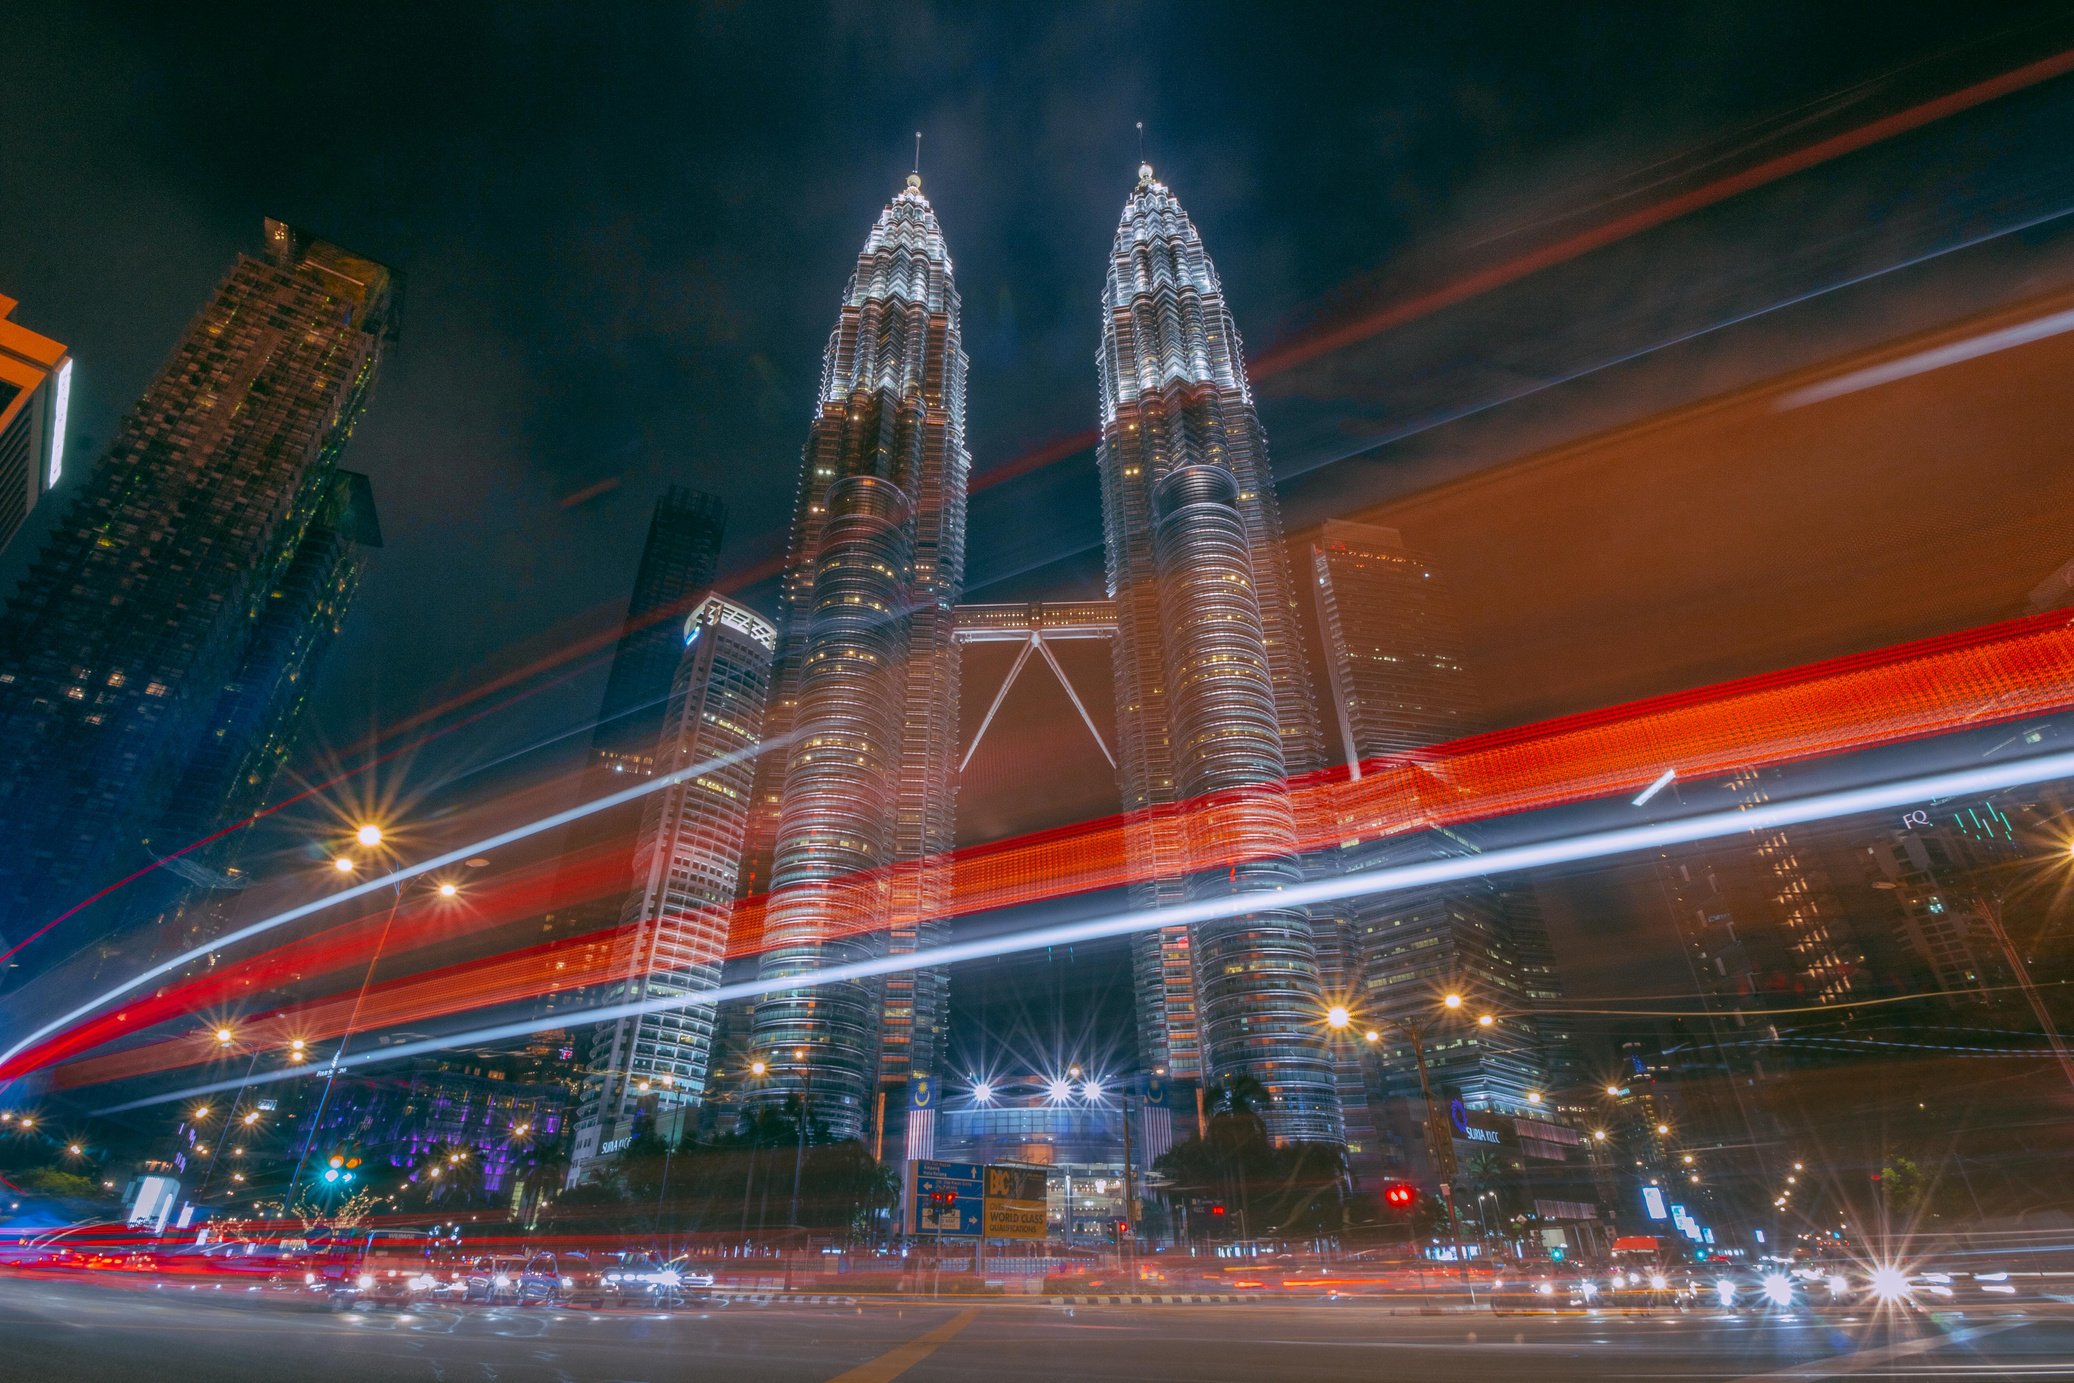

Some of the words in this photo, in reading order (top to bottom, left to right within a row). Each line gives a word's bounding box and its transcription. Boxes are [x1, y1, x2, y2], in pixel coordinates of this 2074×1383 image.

[1466, 1126, 1487, 1142] SURIA
[1486, 1130, 1501, 1144] KLCC
[990, 1212, 1019, 1223] WORLD
[1021, 1214, 1044, 1225] CLASS
[990, 1224, 1038, 1233] QUALIFICATIONS
